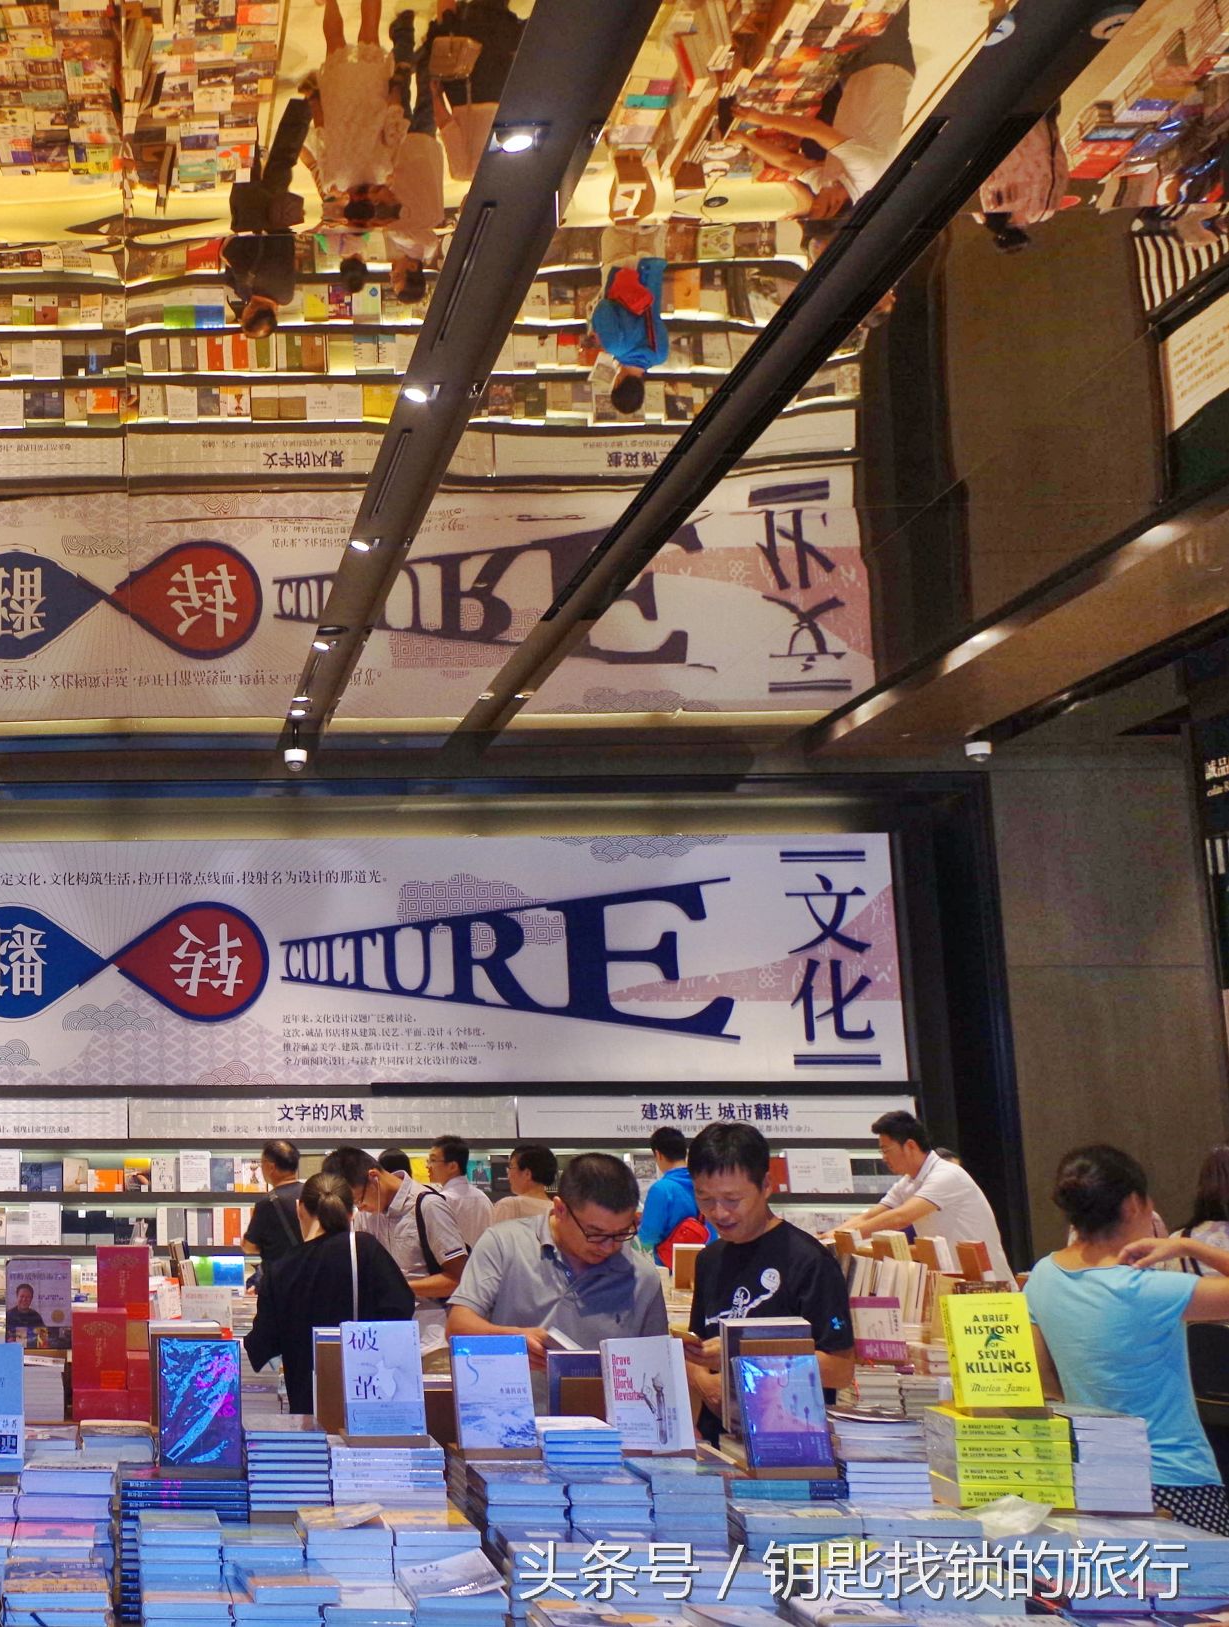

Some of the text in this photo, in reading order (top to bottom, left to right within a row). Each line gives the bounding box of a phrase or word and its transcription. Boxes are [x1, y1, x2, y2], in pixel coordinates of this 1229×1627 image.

[280, 877, 741, 1043] CULTURE
[785, 873, 877, 1042] 文化
[276, 1103, 365, 1121] 文字的风景
[641, 1102, 789, 1121] 建筑新生 城市翻转
[983, 1314, 1009, 1322] BRIEF
[964, 1325, 1020, 1335] HISTORY
[612, 1354, 631, 1365] Brave
[978, 1350, 1016, 1360] SEVEN
[965, 1362, 1032, 1373] KILLINGS
[614, 1377, 633, 1389] World
[1003, 1383, 1030, 1392] James
